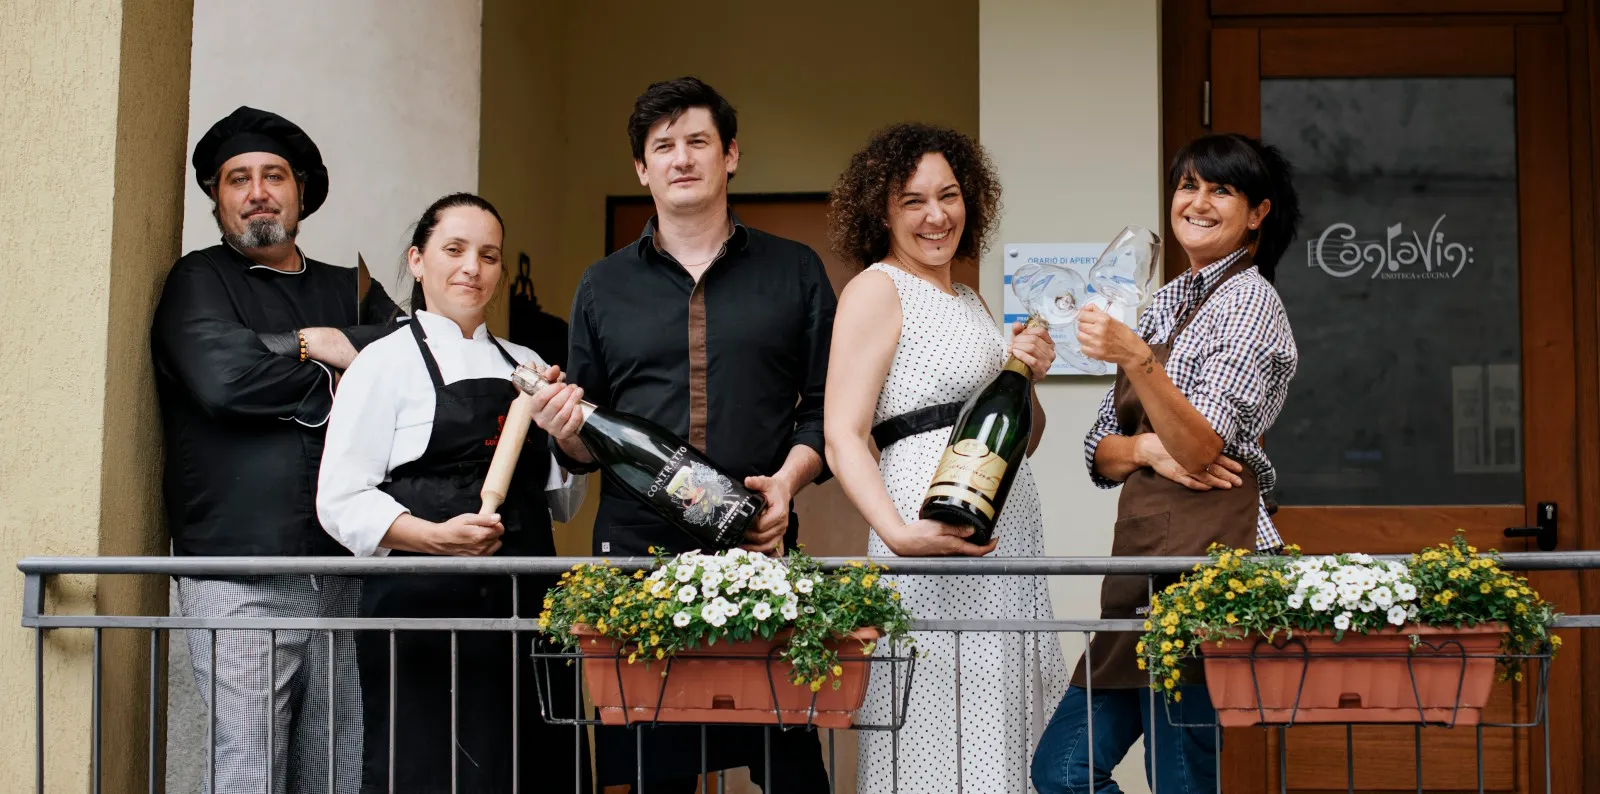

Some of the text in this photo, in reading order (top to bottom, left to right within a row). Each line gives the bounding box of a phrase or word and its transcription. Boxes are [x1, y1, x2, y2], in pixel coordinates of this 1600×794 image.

[1027, 257, 1058, 265] ORARIO
[1059, 257, 1068, 265] DI
[1381, 272, 1416, 280] ENOTECA
[1421, 272, 1450, 280] CUCINA
[647, 446, 688, 498] CONTRATTO
